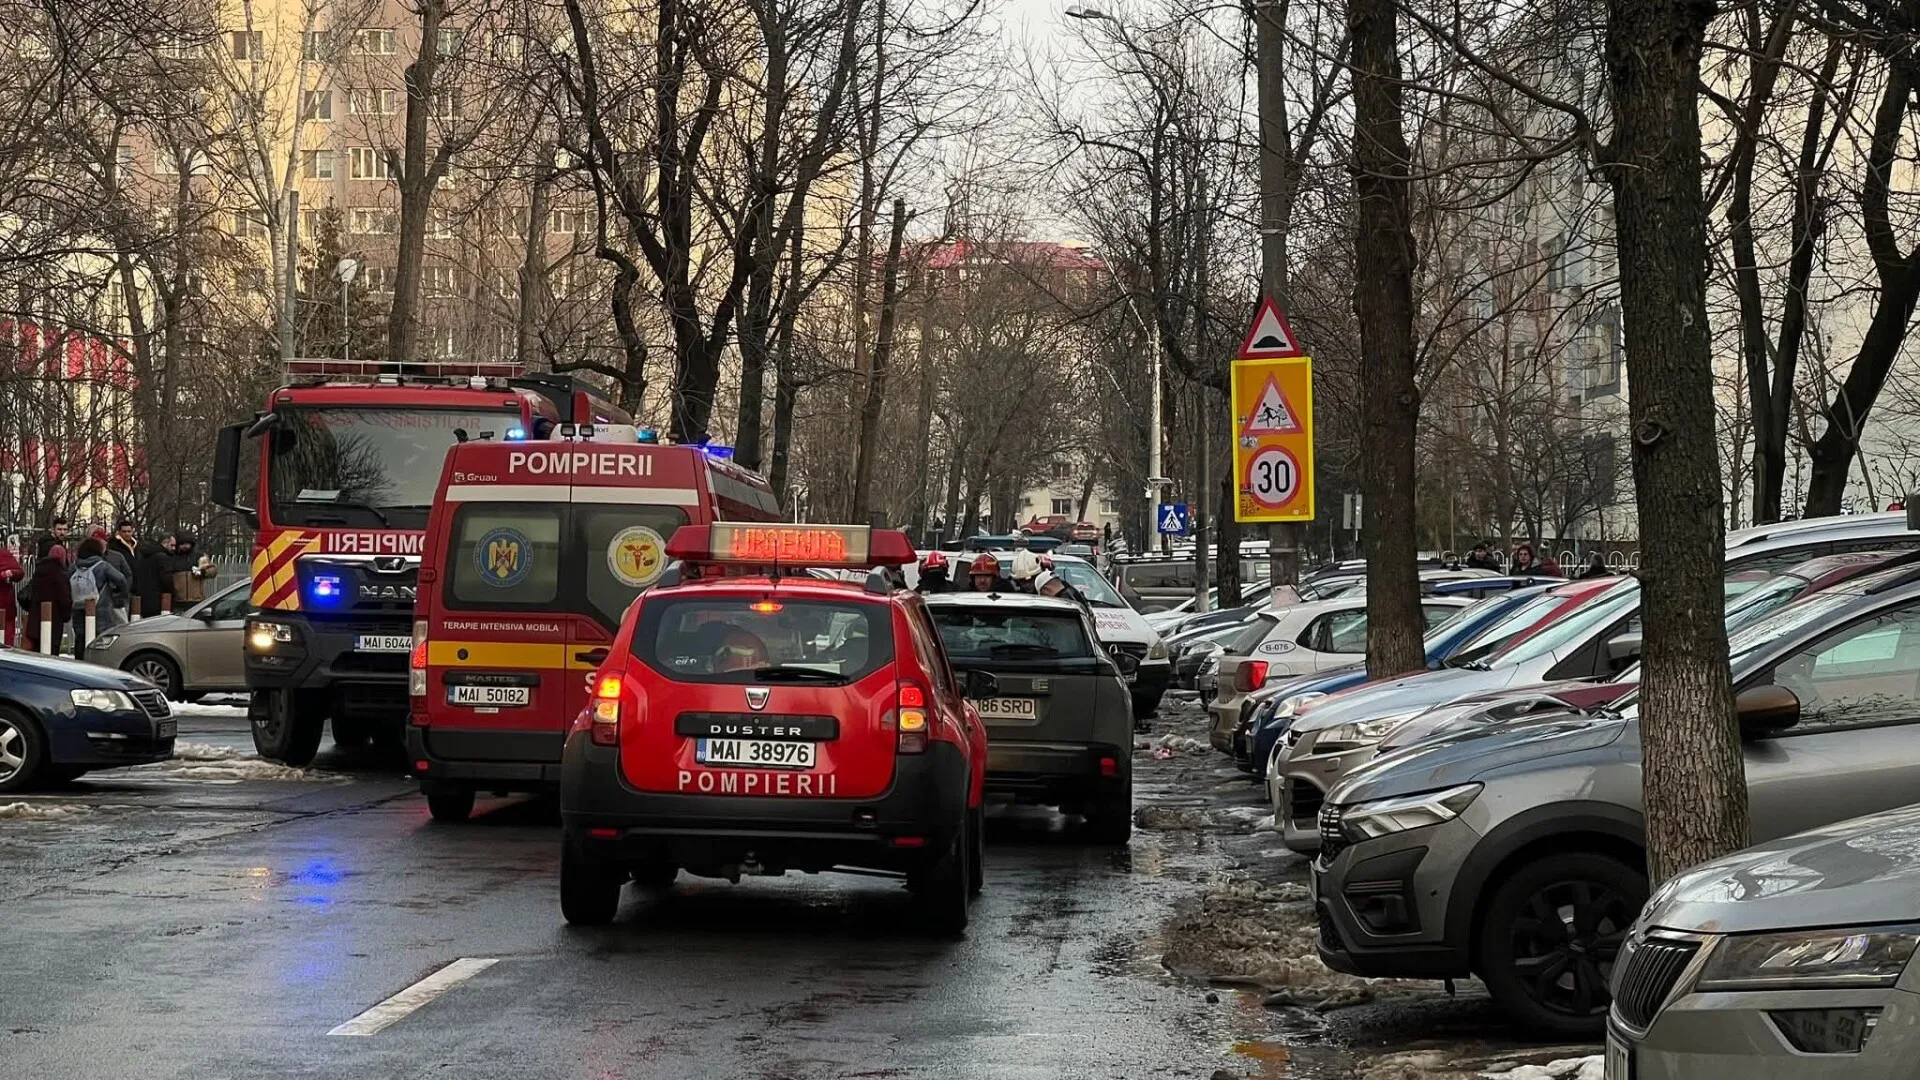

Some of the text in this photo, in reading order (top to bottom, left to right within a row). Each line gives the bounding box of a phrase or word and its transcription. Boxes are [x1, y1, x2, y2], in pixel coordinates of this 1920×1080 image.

[509, 452, 652, 476] POMPIERII
[467, 473, 497, 482] Gruau
[1258, 460, 1290, 493] 30
[360, 585, 416, 599] MAN
[443, 622, 559, 632] TERAPIE INTENSIVA MOBILA
[364, 637, 380, 648] MAI
[458, 688, 524, 703] MAI 50182
[1001, 700, 1033, 714] SRD
[710, 724, 802, 736] DUSTER
[711, 740, 741, 760] MAI
[749, 742, 809, 763] 38976
[678, 770, 836, 794] POMPIERII
